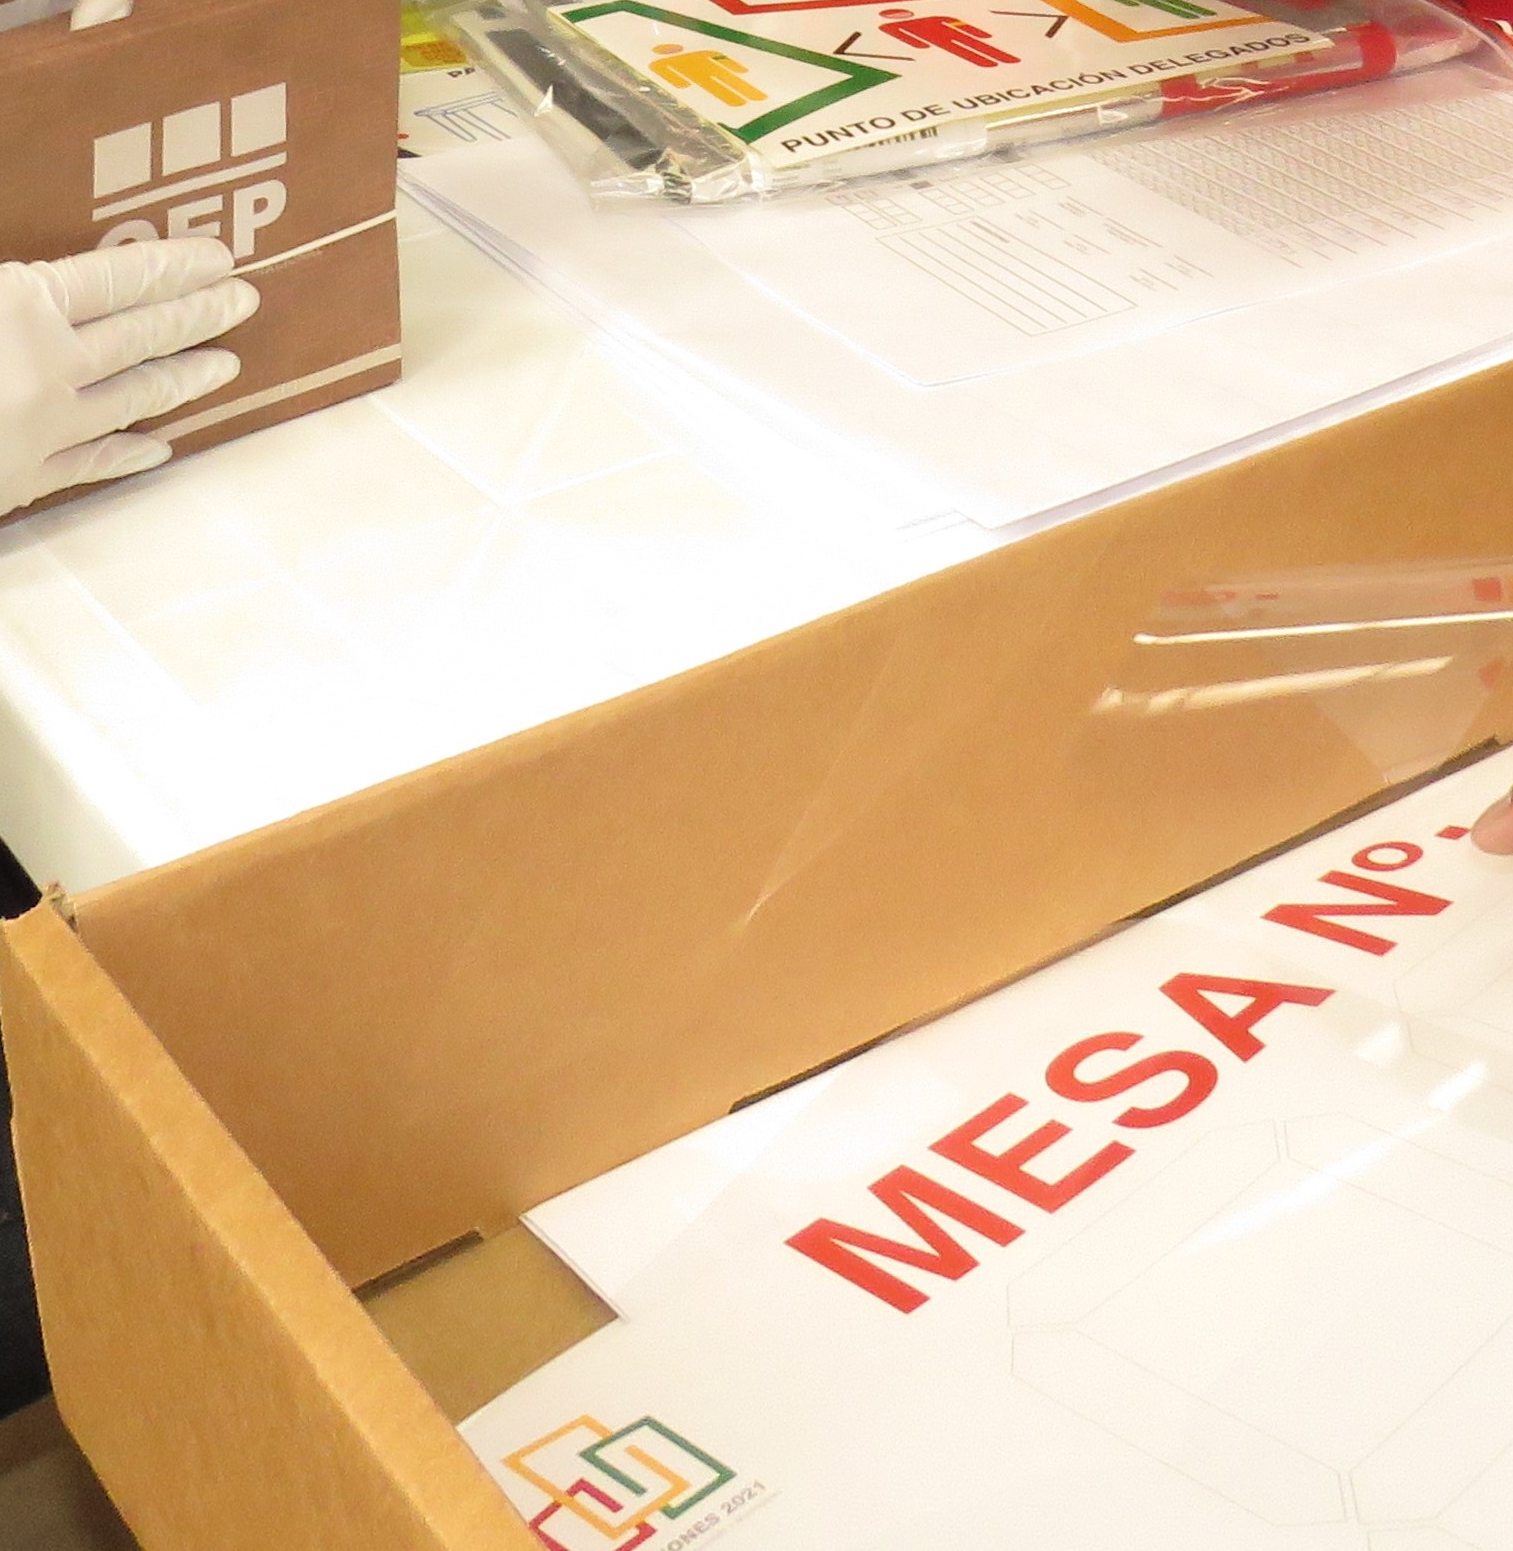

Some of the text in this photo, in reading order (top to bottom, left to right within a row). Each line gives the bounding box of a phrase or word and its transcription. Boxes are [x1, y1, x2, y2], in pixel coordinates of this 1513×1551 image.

[780, 115, 896, 154] PUNTO
[901, 96, 953, 122] DE
[953, 67, 1126, 112] UBICACIÓN
[1128, 31, 1312, 78] DELEGADOS
[783, 972, 1337, 1315] MESA
[659, 1479, 768, 1551] ONES 2021
